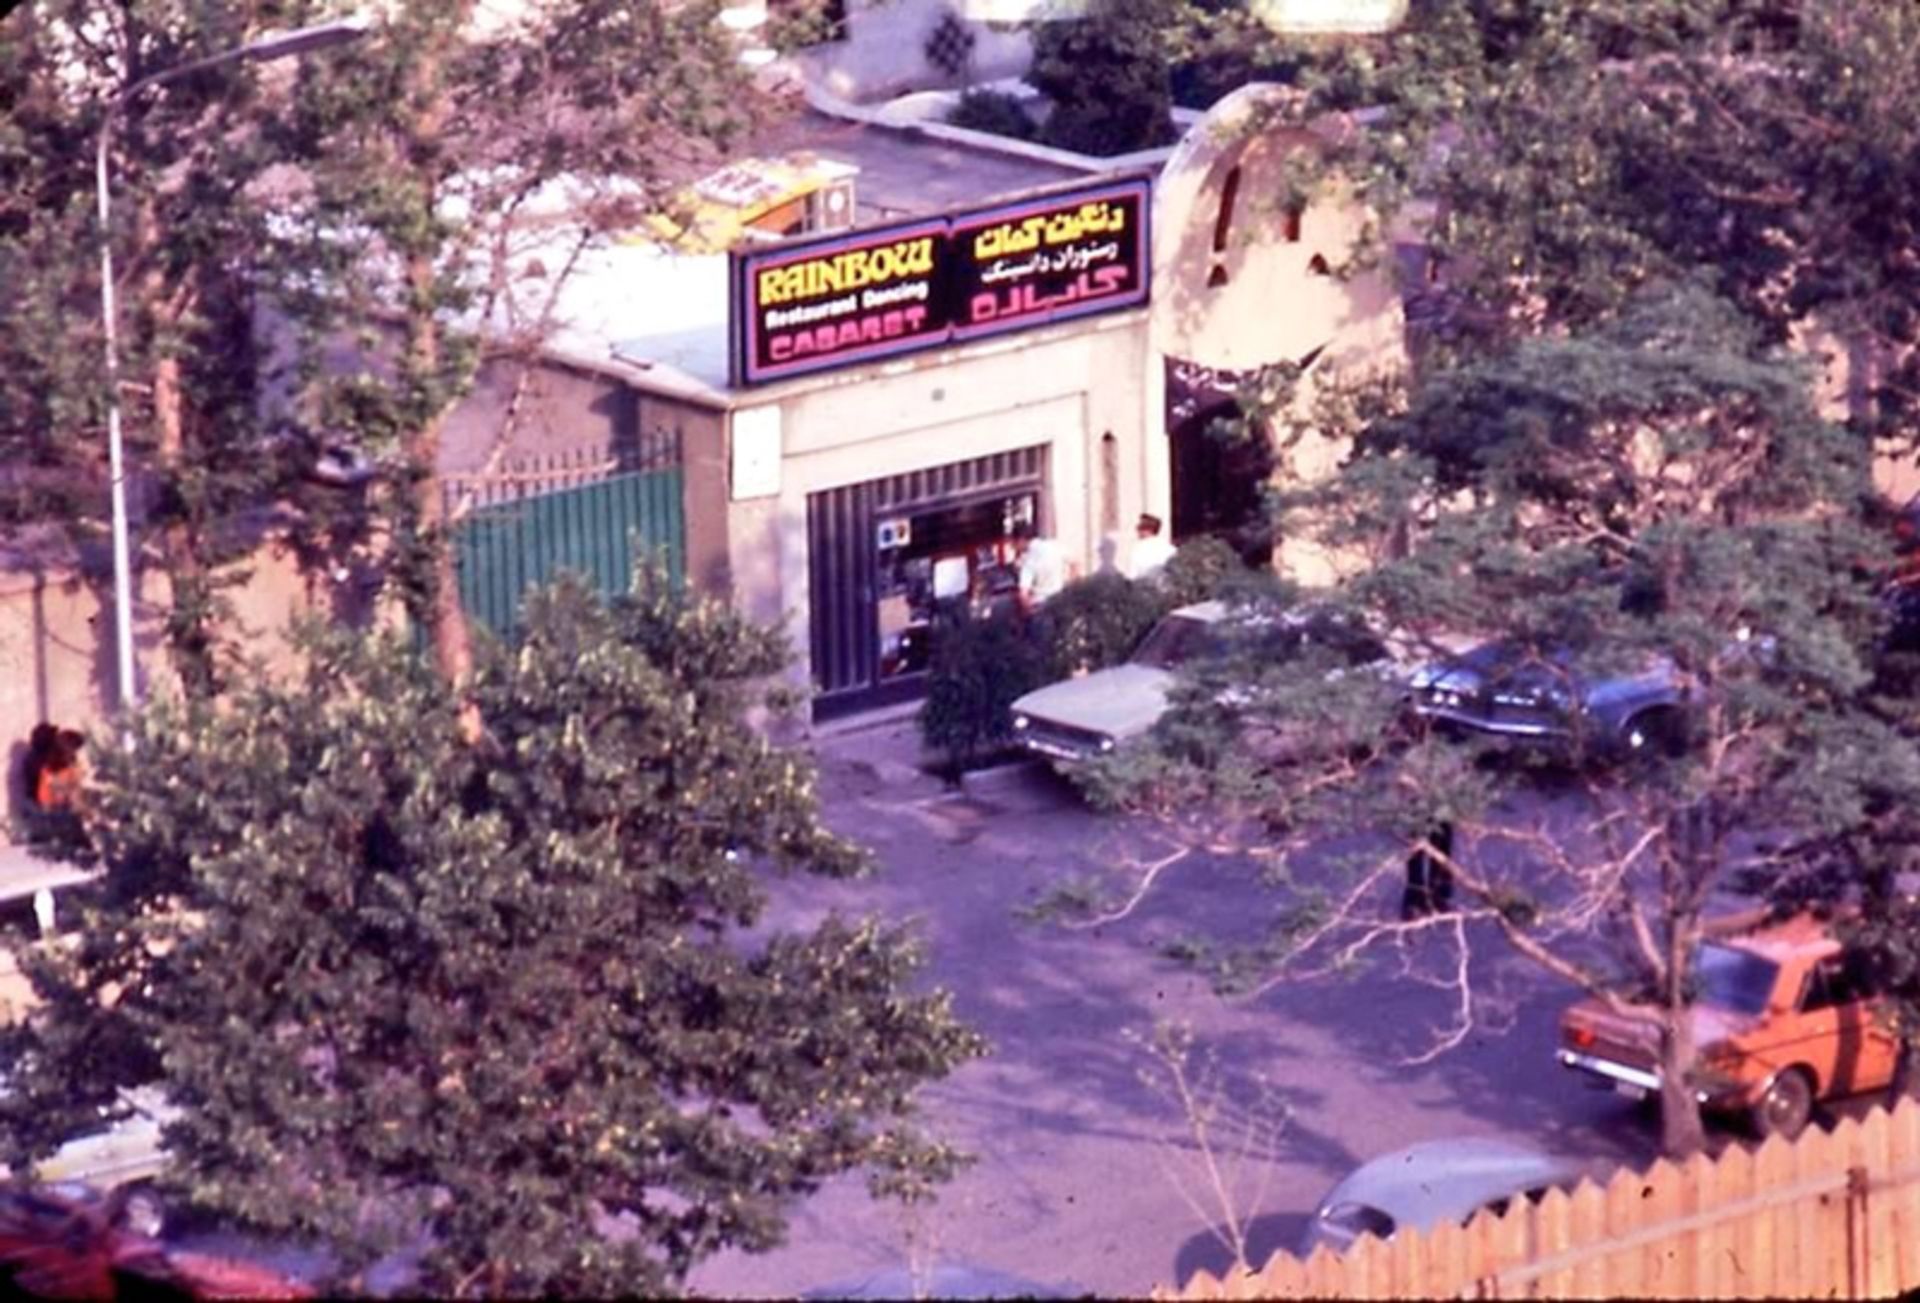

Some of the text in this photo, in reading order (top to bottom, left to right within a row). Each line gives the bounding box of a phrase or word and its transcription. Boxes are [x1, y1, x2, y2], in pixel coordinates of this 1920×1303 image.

[974, 217, 1046, 259] کمان
[760, 238, 932, 305] RAINBOW
[765, 280, 929, 329] Restaurant Dancing
[770, 306, 926, 360] CABARET
